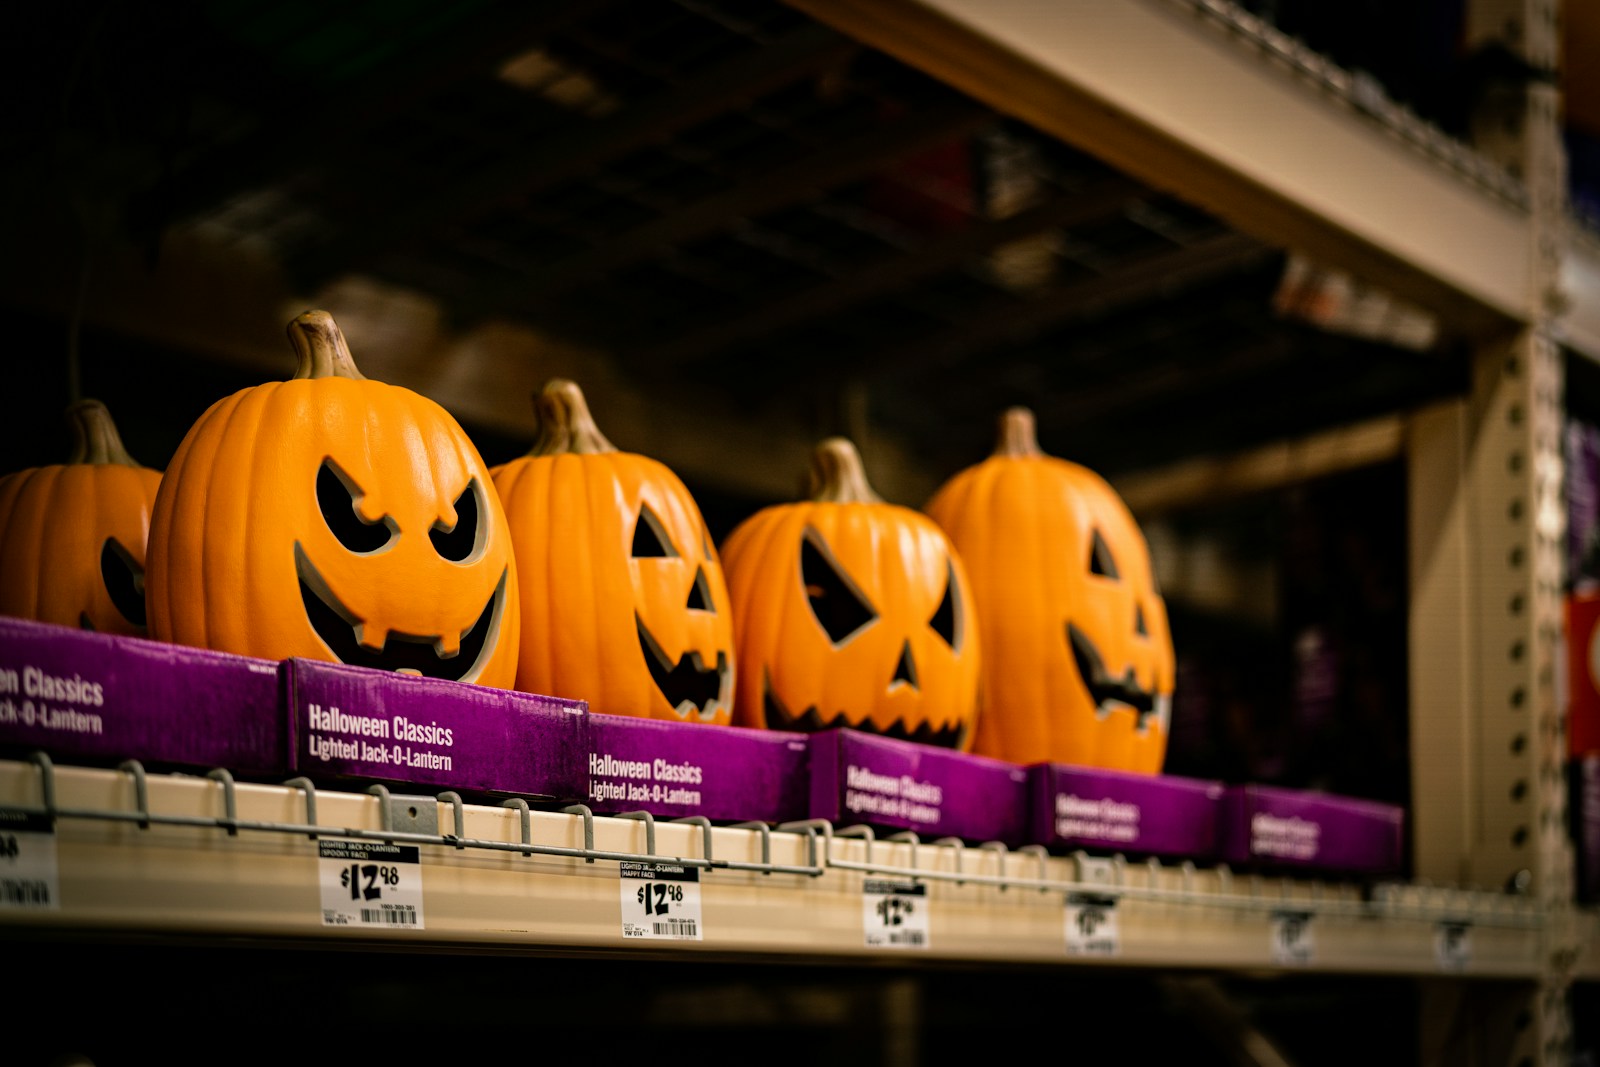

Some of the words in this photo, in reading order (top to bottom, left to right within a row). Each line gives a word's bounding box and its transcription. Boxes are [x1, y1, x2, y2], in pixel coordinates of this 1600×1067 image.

[23, 665, 104, 707] Classics
[0, 697, 103, 735] ck-O-Lantern
[308, 703, 390, 738] Halloween
[393, 716, 454, 747] Classics
[308, 734, 359, 762] Lighted
[360, 741, 452, 771] Jack-O-Lantern
[589, 753, 651, 780] Halloween
[653, 758, 702, 785] Classics
[589, 780, 626, 803] Lighted
[627, 782, 701, 806] Jack-O-Lantern
[320, 841, 347, 849] LIGHTED
[348, 843, 400, 853] JACK-O-LANTERN
[643, 864, 684, 873] JA-O-LANTERN
